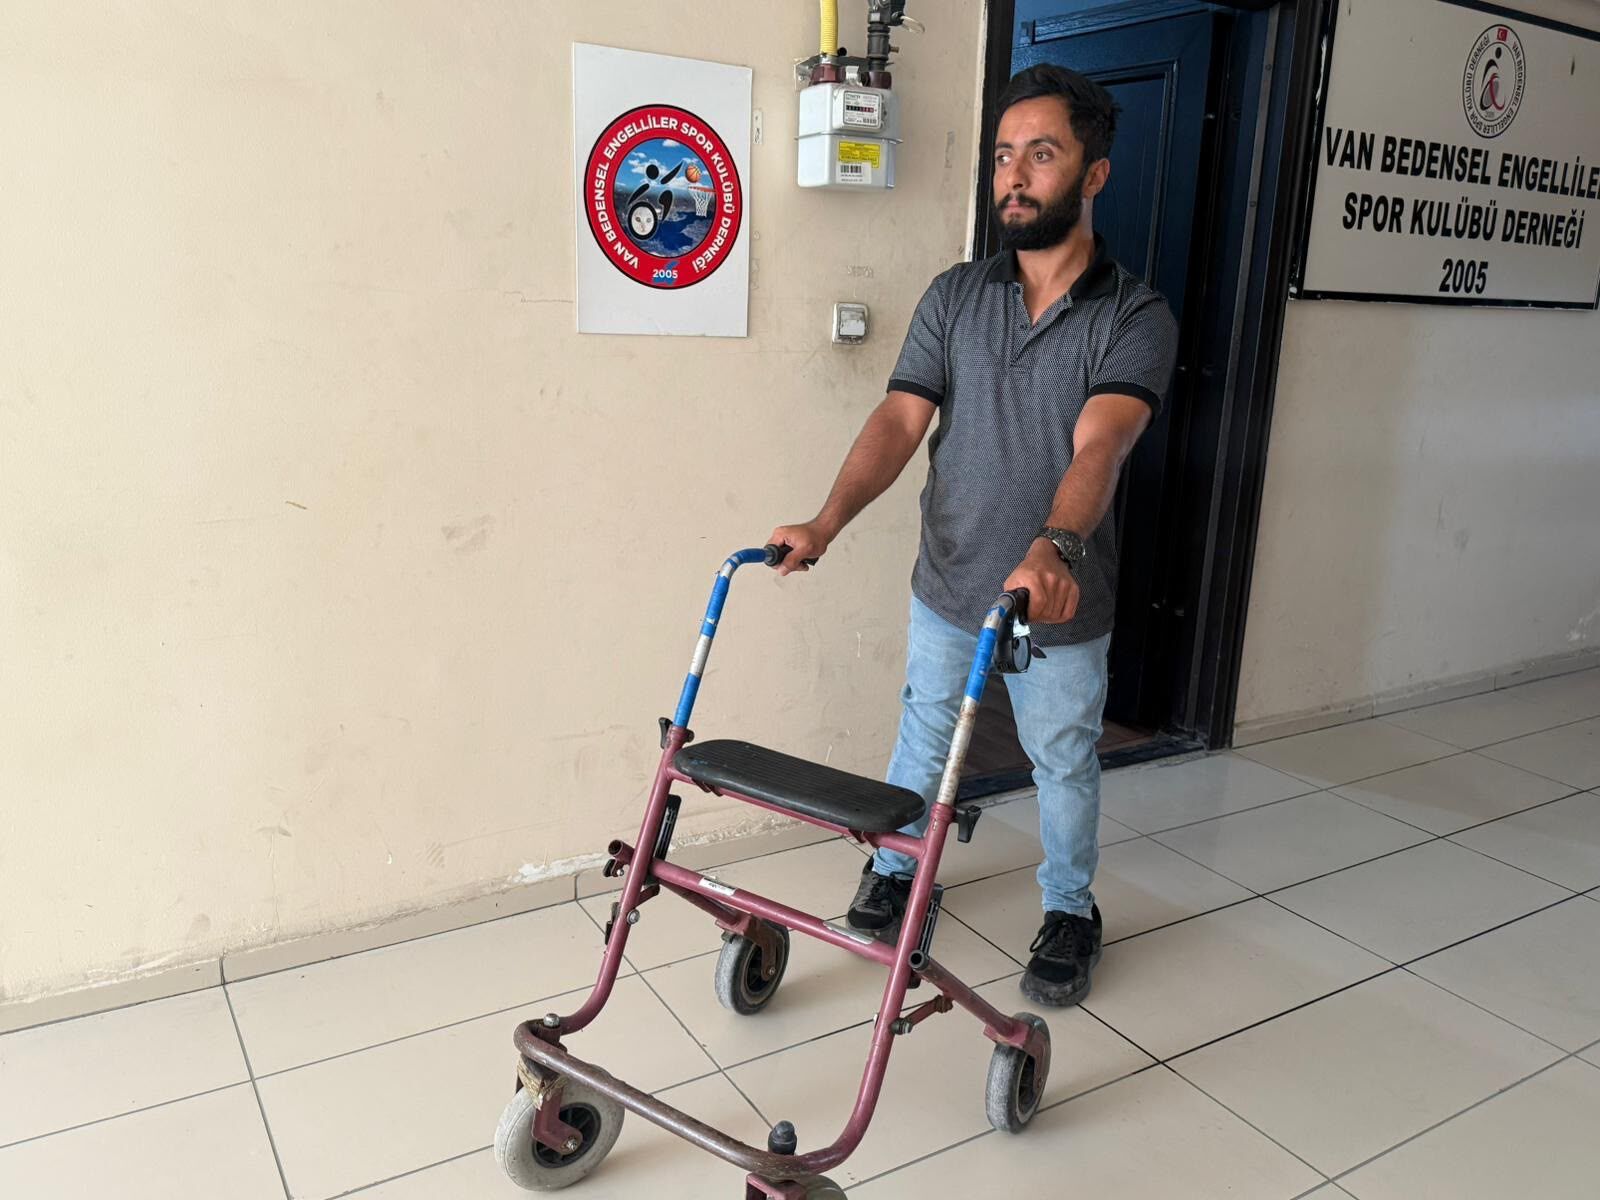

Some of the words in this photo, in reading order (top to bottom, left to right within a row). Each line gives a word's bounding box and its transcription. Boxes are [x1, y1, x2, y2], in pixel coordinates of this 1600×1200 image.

[603, 114, 678, 159] ENGELLİLER
[680, 122, 713, 153] SPOR
[711, 153, 736, 214] KULÜBÜ
[1325, 126, 1375, 171] VAN
[1380, 135, 1491, 185] BEDENSEL
[1497, 152, 1600, 200] ENGELLİLE
[595, 162, 617, 242] BEDENSEL
[1342, 191, 1405, 234] SPOR
[1409, 196, 1498, 241] KULÜBÜ
[1501, 208, 1585, 249] DERNEĞİ
[613, 241, 639, 269] VAN
[692, 218, 731, 272] DERNEĞİ
[652, 269, 678, 279] 2005
[1438, 258, 1489, 294] 2005
